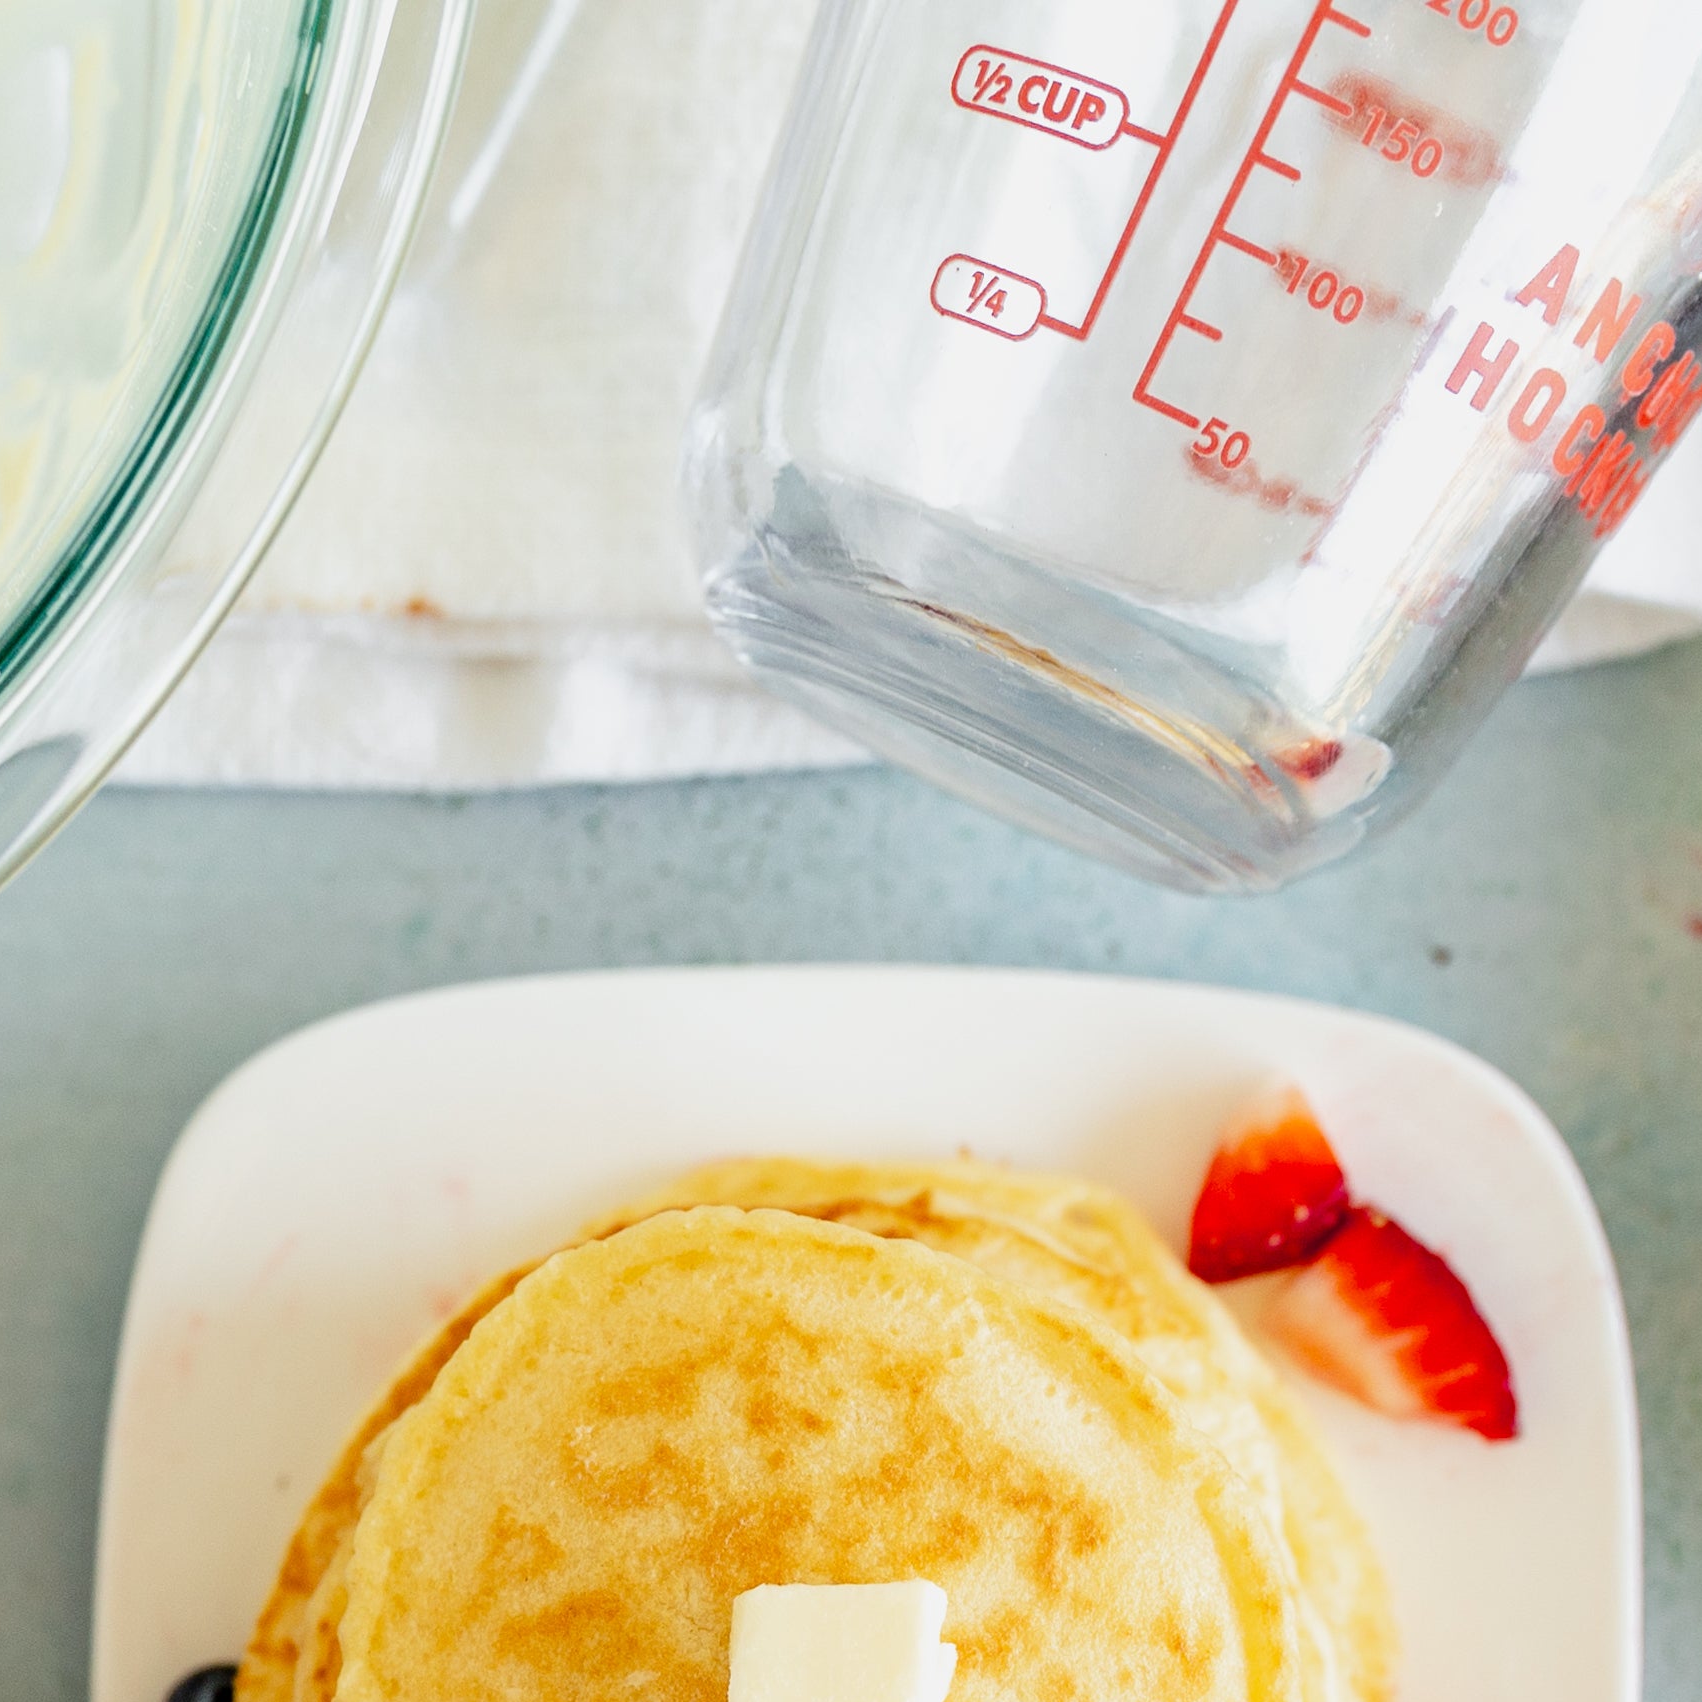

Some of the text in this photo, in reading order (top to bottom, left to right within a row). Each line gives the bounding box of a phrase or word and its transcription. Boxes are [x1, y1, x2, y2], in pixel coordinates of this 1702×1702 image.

[1017, 74, 1108, 131] CUP
[1359, 105, 1443, 179] 150
[965, 270, 1008, 319] 1/4
[1285, 256, 1365, 325] 100
[1191, 416, 1252, 470] 50
